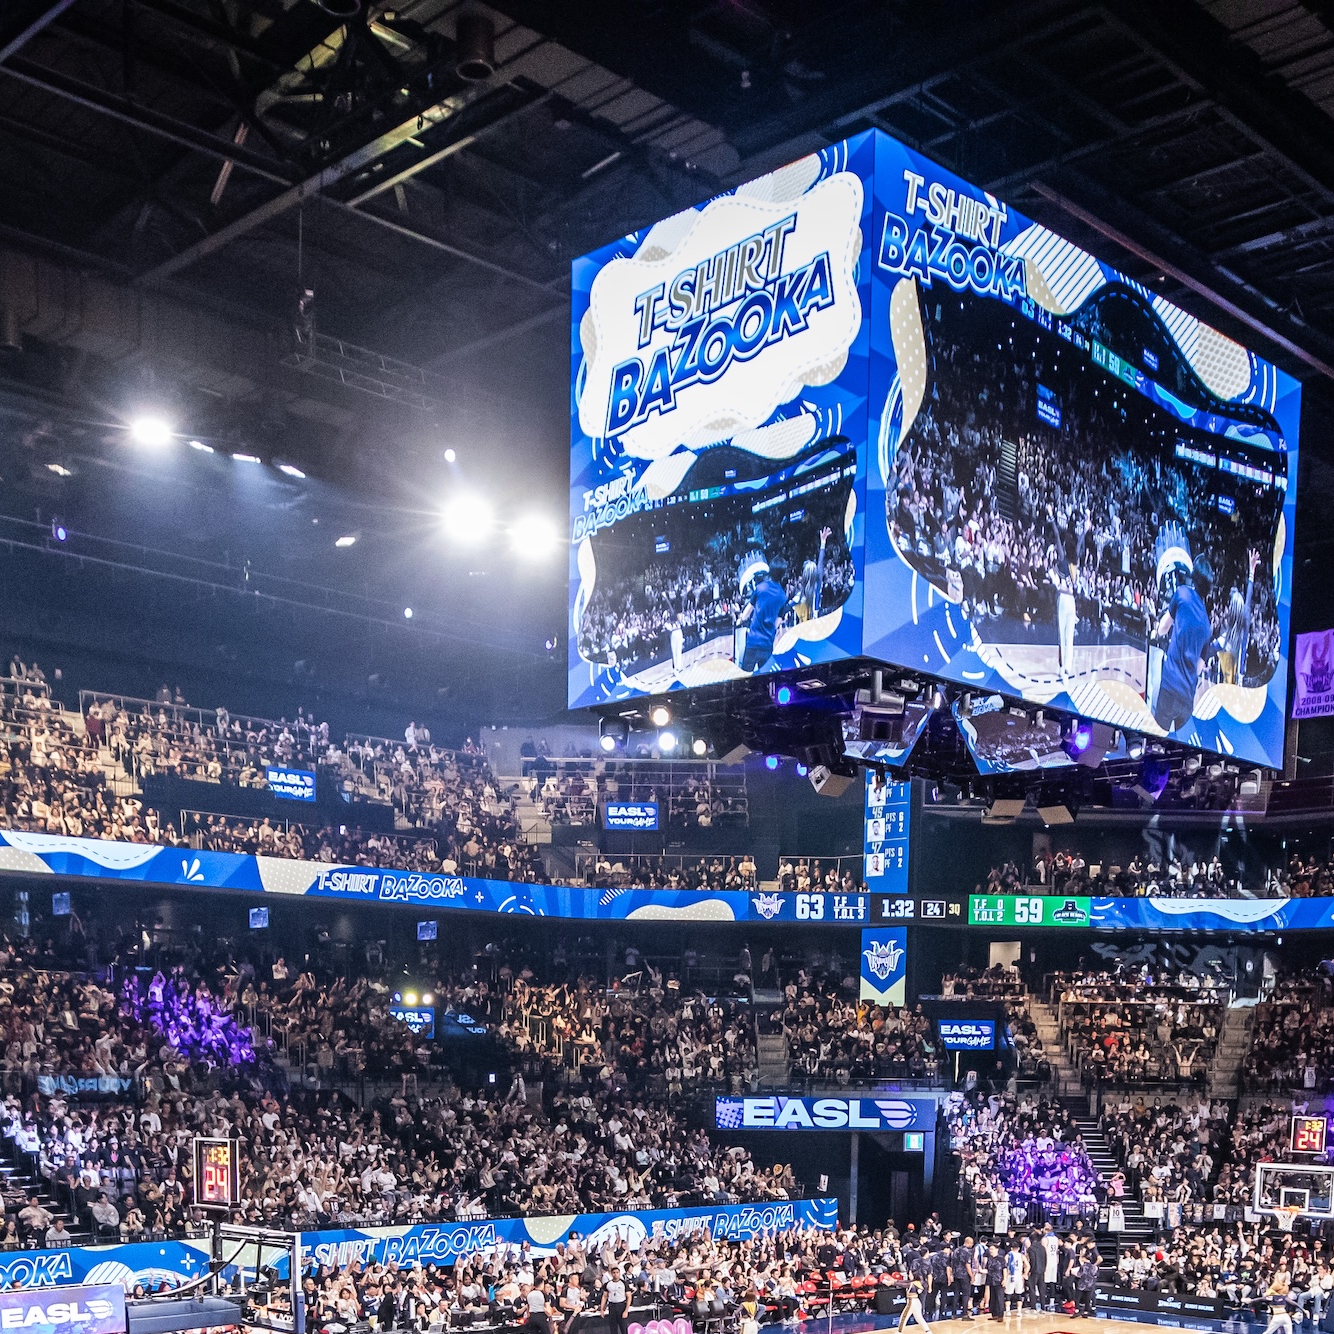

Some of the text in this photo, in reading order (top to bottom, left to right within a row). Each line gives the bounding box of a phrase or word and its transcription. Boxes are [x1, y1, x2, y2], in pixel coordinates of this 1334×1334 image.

[903, 169, 1007, 249] T-SHIRT
[878, 211, 1028, 301] BAZOOKA
[634, 211, 798, 350] T-SHIRT
[605, 251, 835, 438] BAZOOKA
[583, 467, 637, 512] T-SHIRT
[572, 484, 649, 545] BAZOOKA
[268, 772, 304, 786] EASL
[608, 806, 646, 817] EASL
[885, 812, 904, 822] PTS 6
[898, 823, 903, 832] 2
[885, 848, 895, 858] PTS
[898, 858, 903, 868] 2
[317, 871, 464, 901] T-SHIRT BAZOOKA
[796, 894, 865, 920] 63 T.F 0
[834, 909, 865, 920] T.O.L 3
[881, 898, 915, 918] 1:32
[926, 903, 961, 916] 24 3Q
[973, 898, 987, 910] T.F
[997, 898, 1003, 910] 0
[1014, 898, 1044, 923] 59
[974, 910, 1003, 921] T.O.L 2
[940, 1025, 981, 1035] EASL
[743, 1098, 880, 1128] EASL
[1304, 1120, 1323, 1131] 1:32
[1298, 1131, 1320, 1149] 24
[205, 1147, 230, 1163] 1:32
[204, 1166, 228, 1199] 24
[713, 1204, 793, 1241] BAZOOKA
[382, 1224, 497, 1269] BAZOOKA
[1, 1302, 92, 1329] EASL
